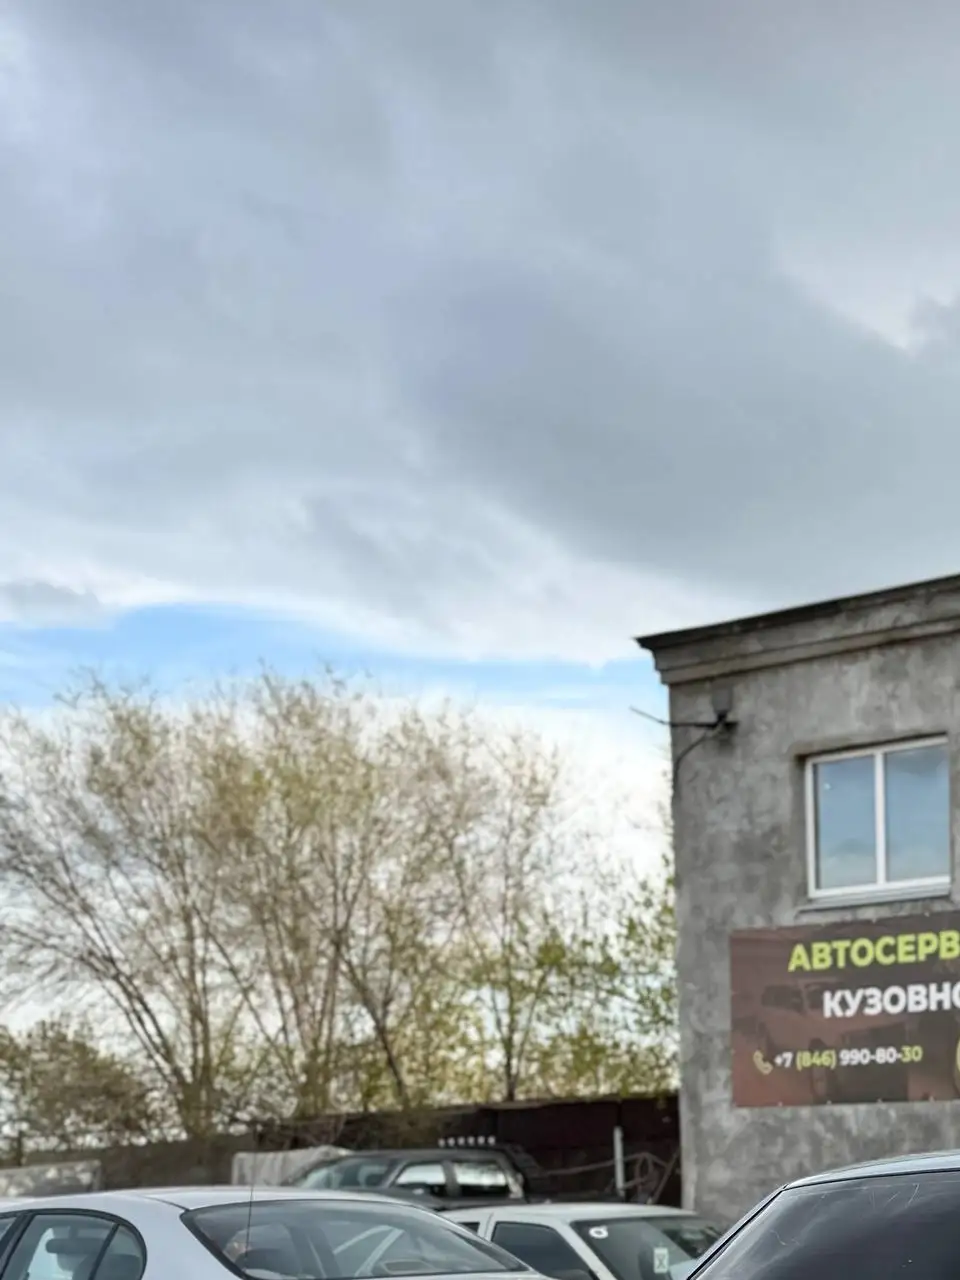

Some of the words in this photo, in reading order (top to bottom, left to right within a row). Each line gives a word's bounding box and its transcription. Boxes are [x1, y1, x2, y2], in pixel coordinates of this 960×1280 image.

[774, 1052, 794, 1068] +7
[796, 1049, 837, 1071] (846)
[839, 1045, 923, 1066] 990-80-30
